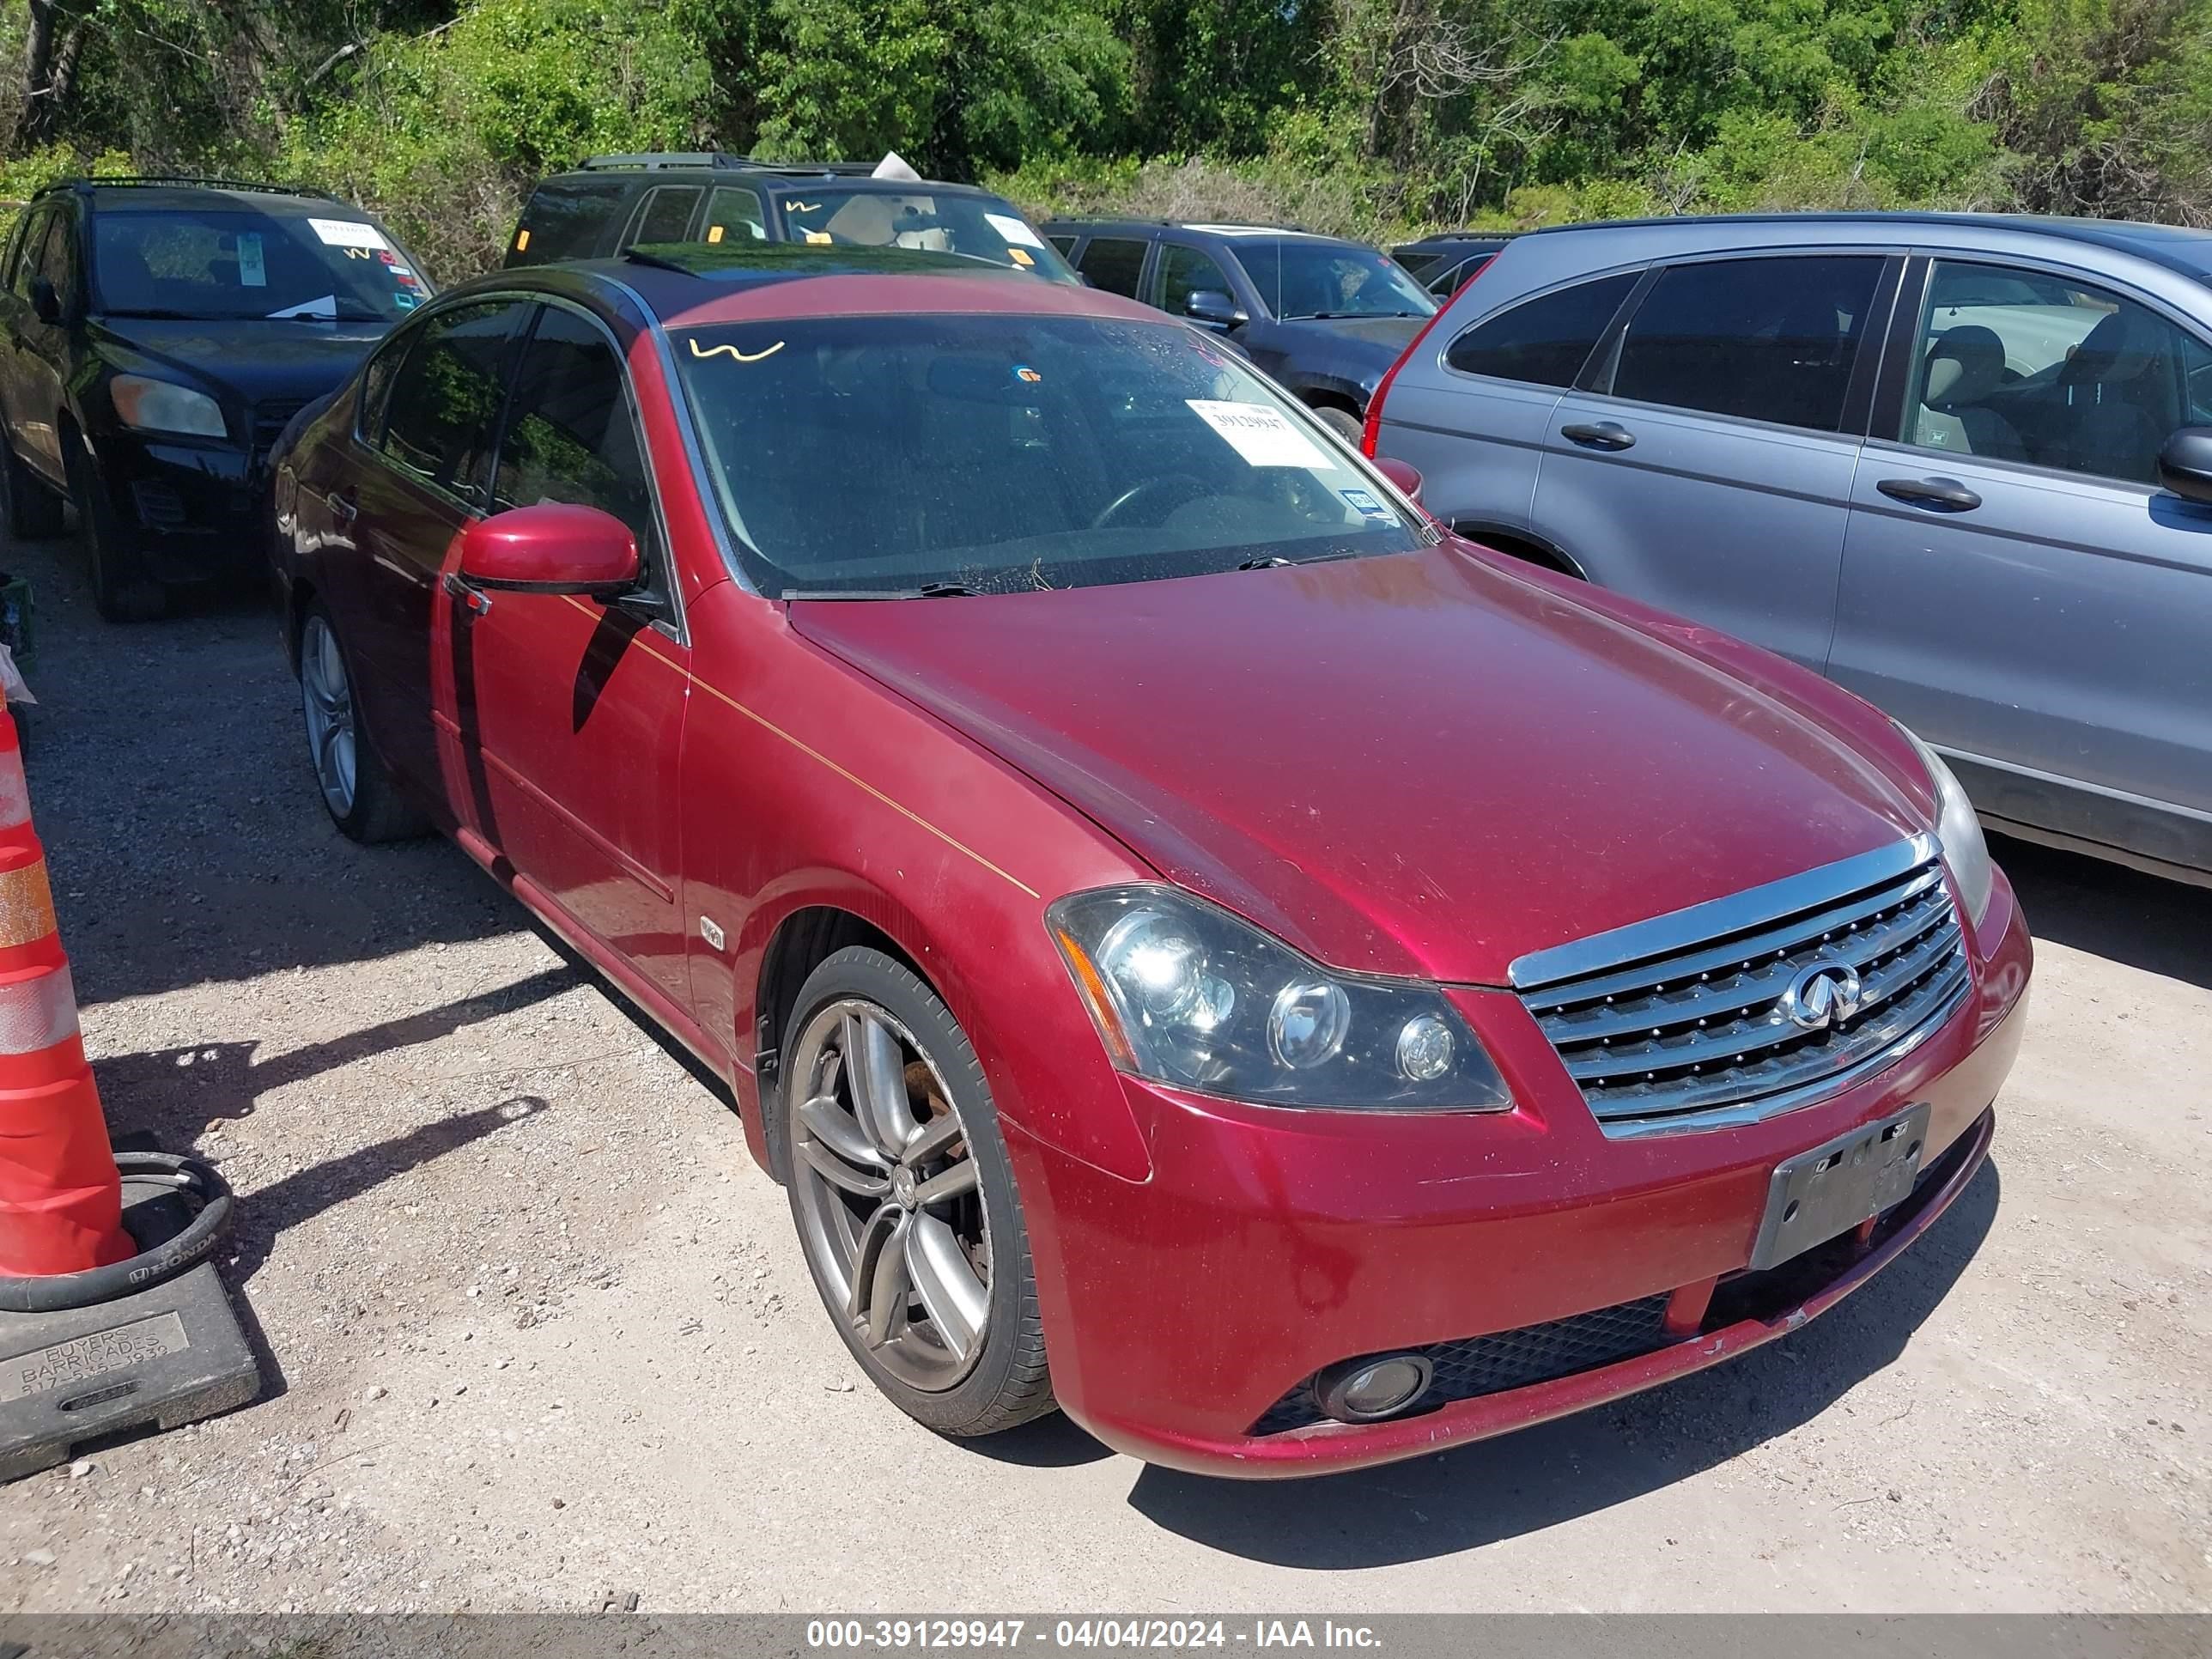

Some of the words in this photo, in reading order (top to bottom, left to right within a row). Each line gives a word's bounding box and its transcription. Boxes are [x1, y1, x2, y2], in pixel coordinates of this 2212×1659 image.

[1212, 414, 1286, 431] 39129947
[21, 1333, 160, 1383] BARRICADES
[45, 1328, 130, 1363] BUYERS
